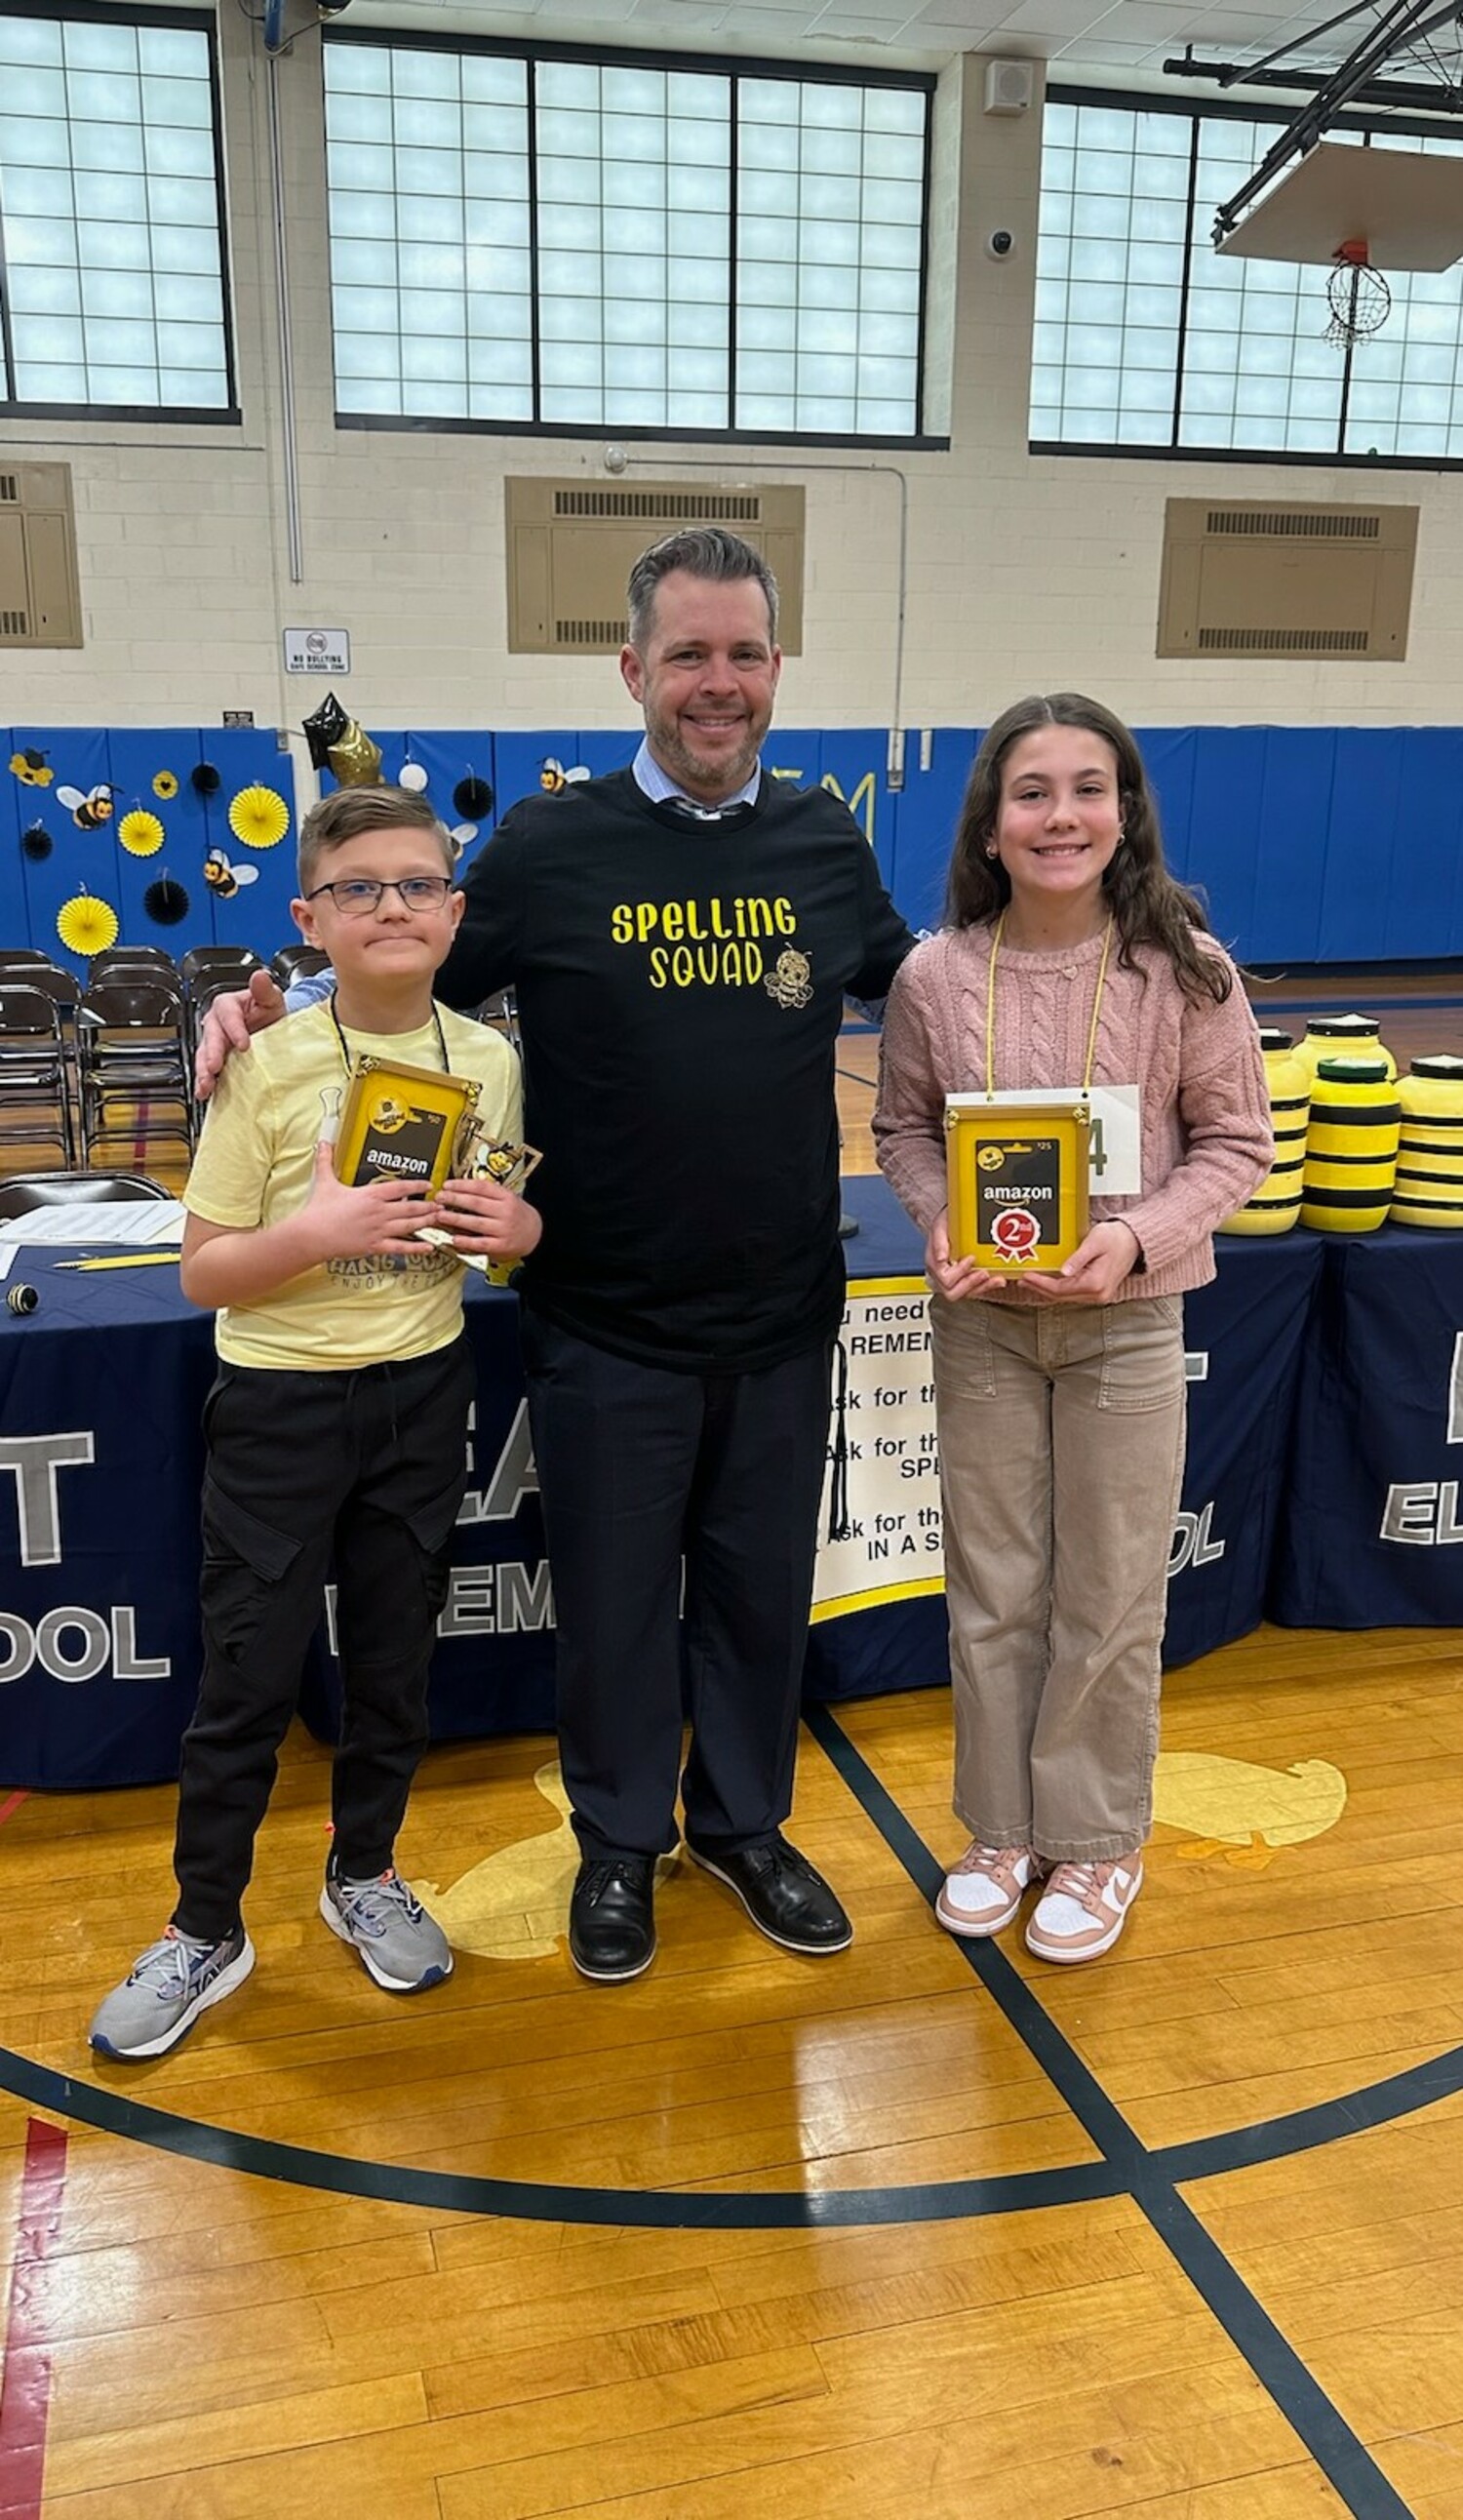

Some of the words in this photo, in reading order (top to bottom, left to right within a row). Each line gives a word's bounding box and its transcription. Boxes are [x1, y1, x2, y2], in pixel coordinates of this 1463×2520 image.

[650, 941, 763, 988] SQUAD
[367, 1149, 429, 1174] amazon
[983, 1185, 1053, 1201] amazon
[865, 1300, 924, 1323] need
[874, 1387, 907, 1408] for
[875, 1437, 907, 1457] for
[875, 1514, 906, 1533] for
[868, 1539, 889, 1561] IN
[900, 1535, 916, 1554] A
